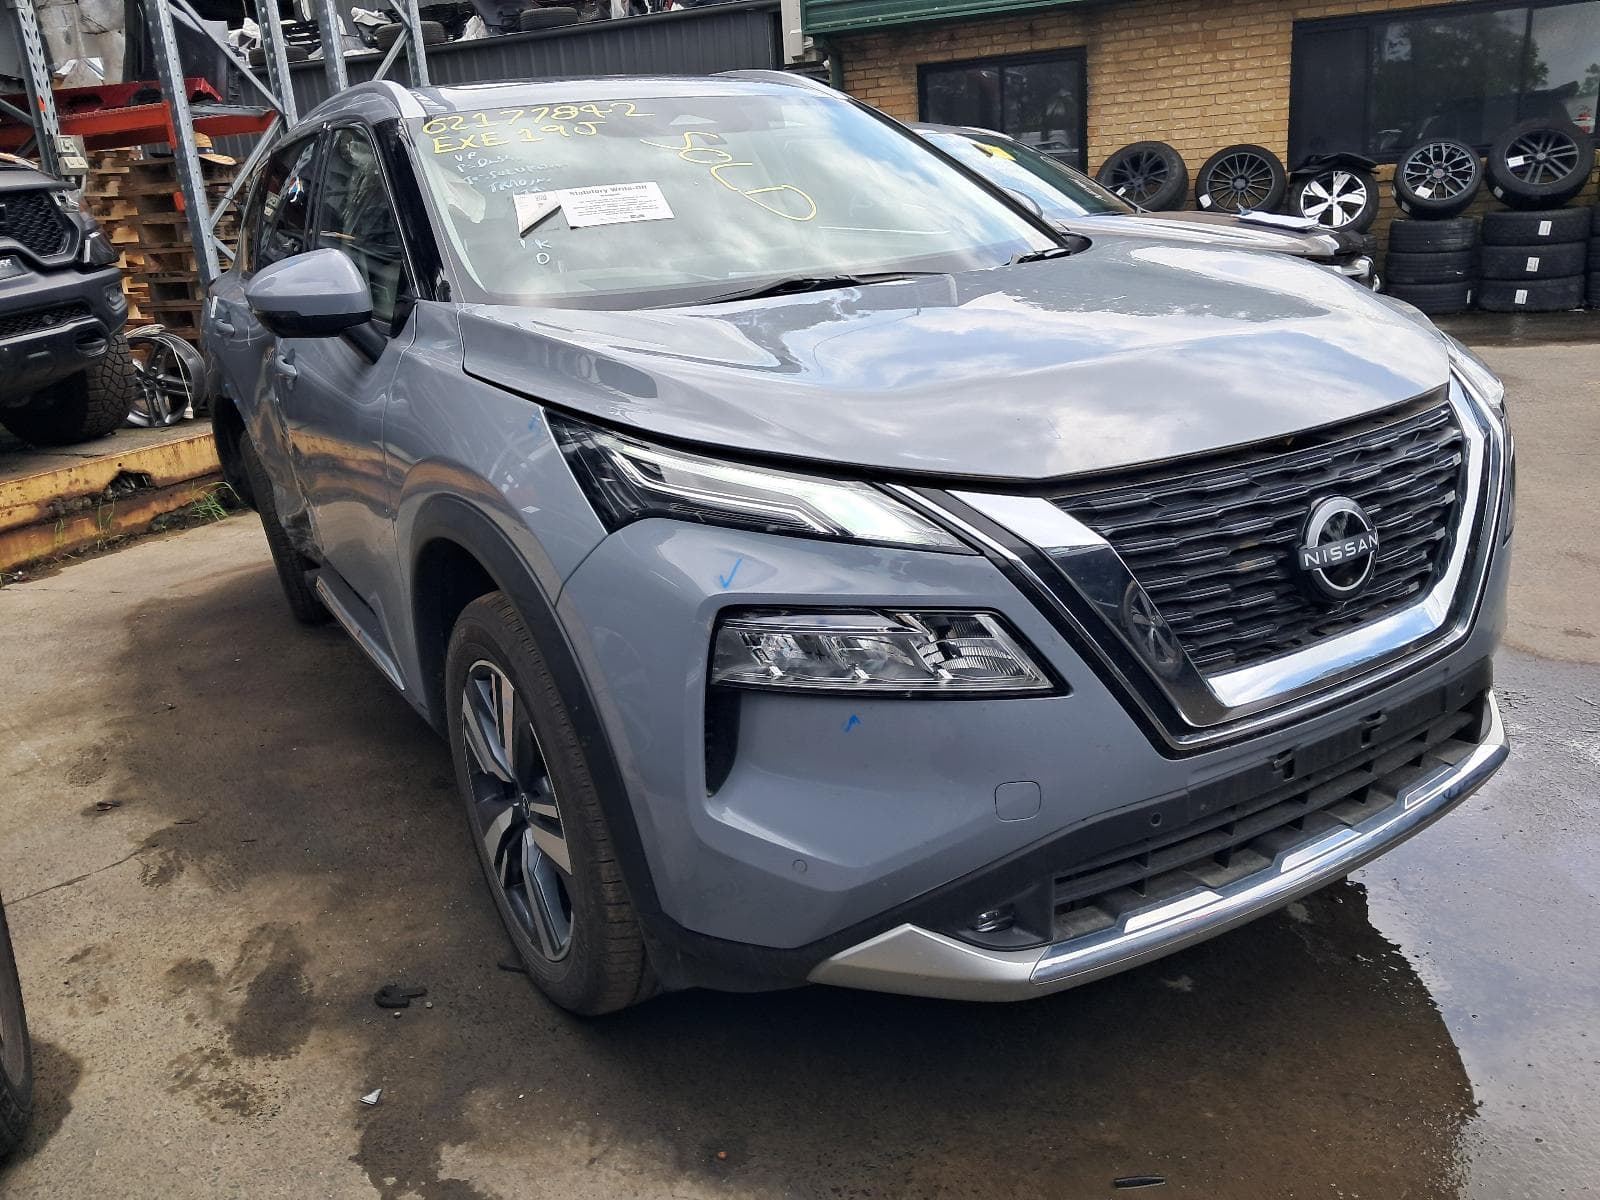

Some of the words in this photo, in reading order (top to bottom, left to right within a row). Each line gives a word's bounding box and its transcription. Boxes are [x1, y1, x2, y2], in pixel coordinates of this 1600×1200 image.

[432, 132, 512, 154] EXE
[569, 188, 608, 197] Statutory
[1304, 533, 1378, 567] NISSAN
